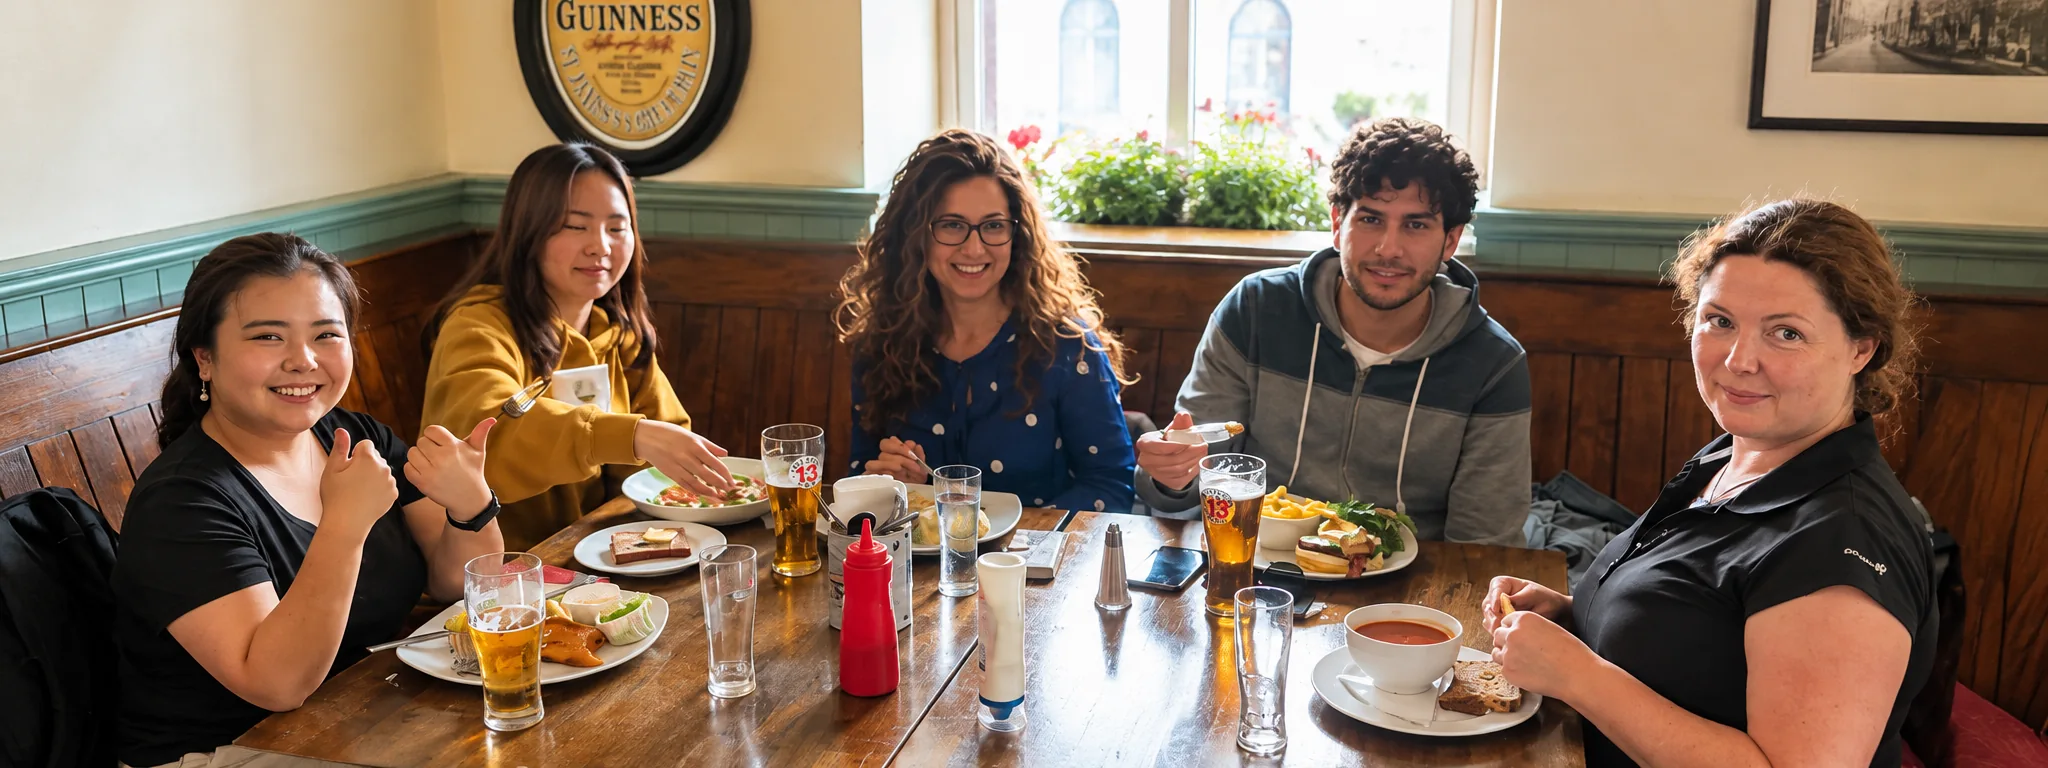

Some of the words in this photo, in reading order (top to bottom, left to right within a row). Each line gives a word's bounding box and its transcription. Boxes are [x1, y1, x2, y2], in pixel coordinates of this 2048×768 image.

[556, 0, 701, 31] GUINNESS
[796, 464, 818, 483] 13
[1207, 497, 1229, 519] 13
